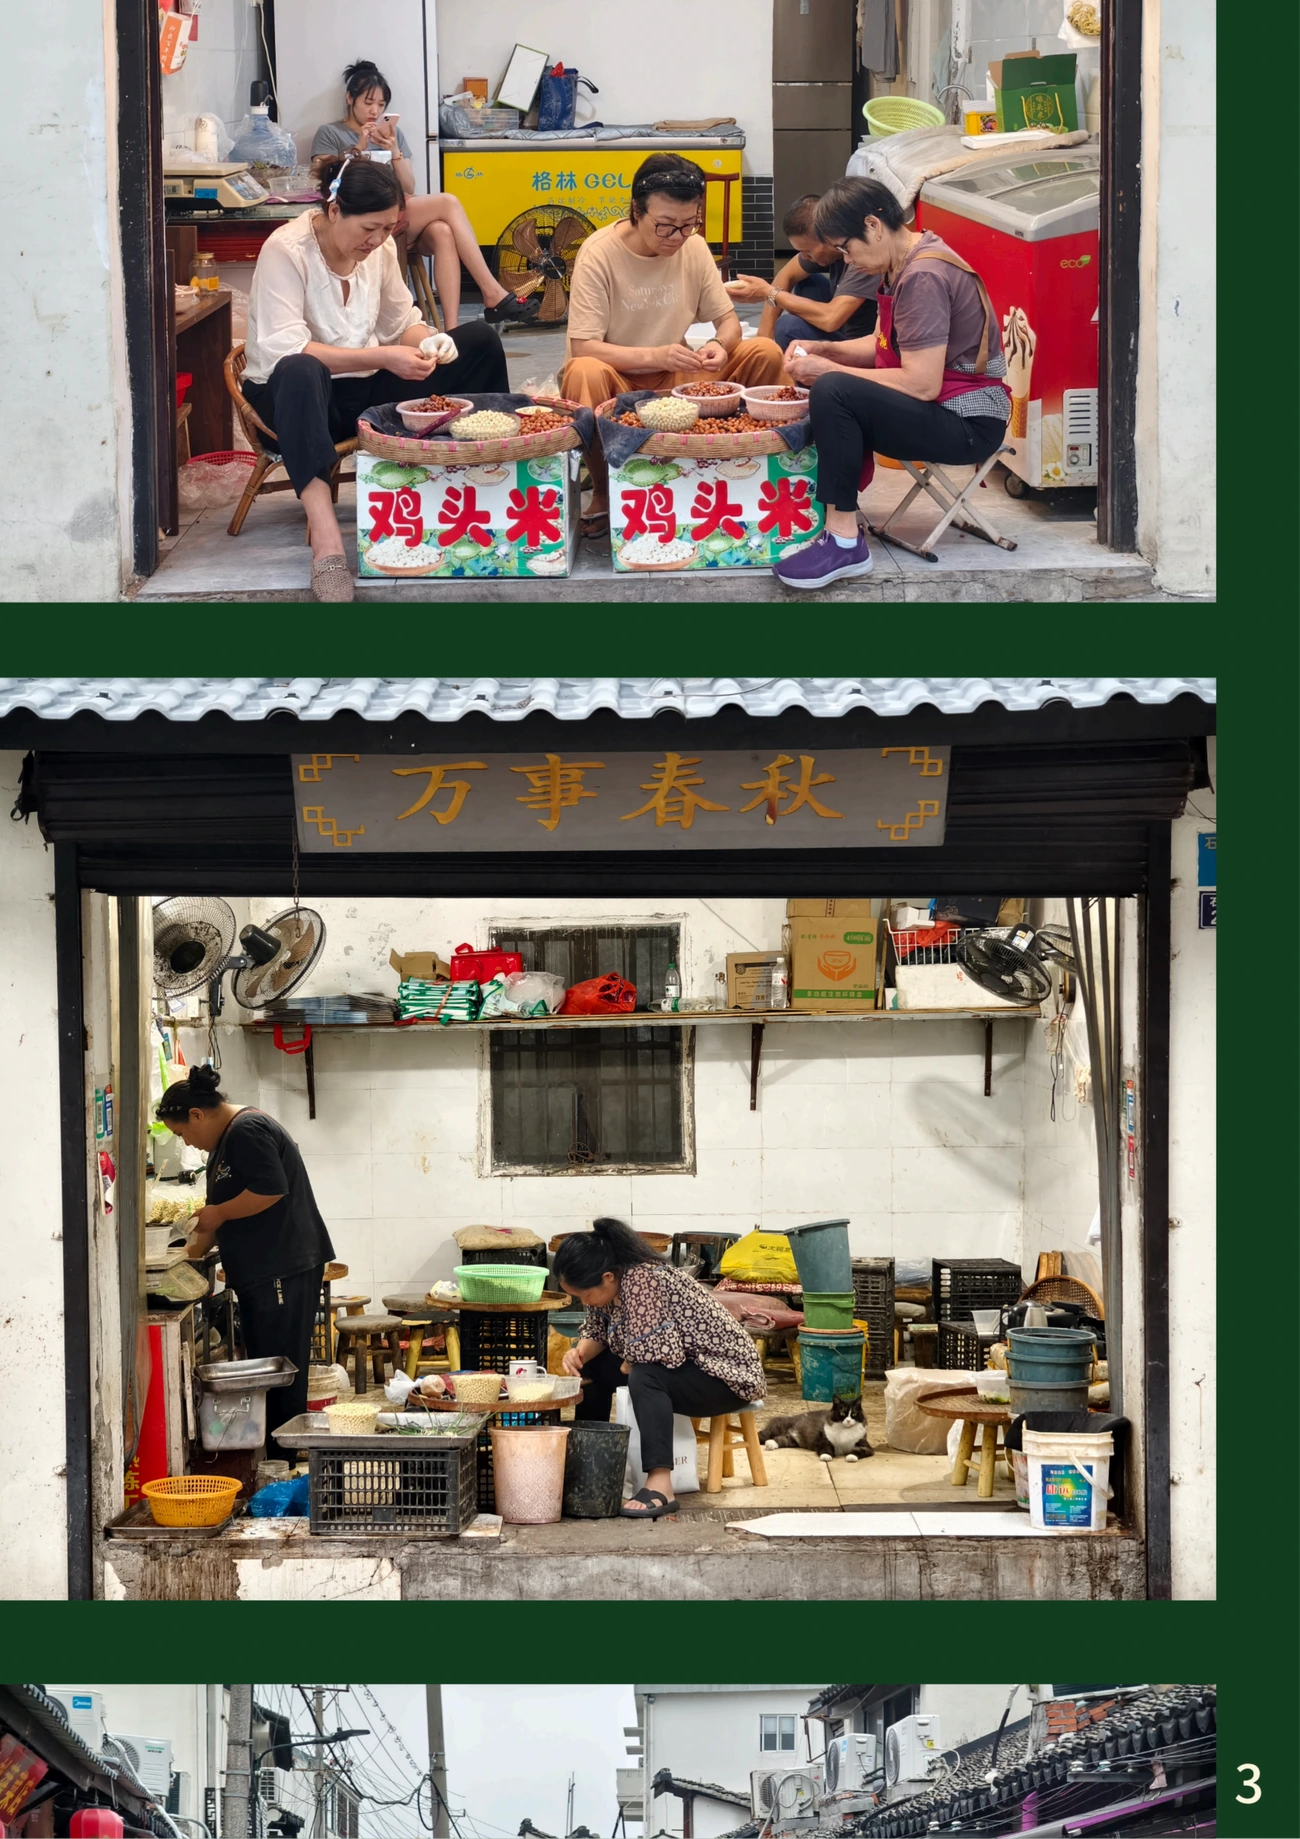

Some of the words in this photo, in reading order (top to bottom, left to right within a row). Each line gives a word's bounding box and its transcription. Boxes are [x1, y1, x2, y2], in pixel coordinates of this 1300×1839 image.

[532, 171, 577, 191] 格林
[368, 486, 561, 547] 鸡头米
[621, 477, 813, 543] 鸡头米
[392, 752, 846, 832] 万事春秋
